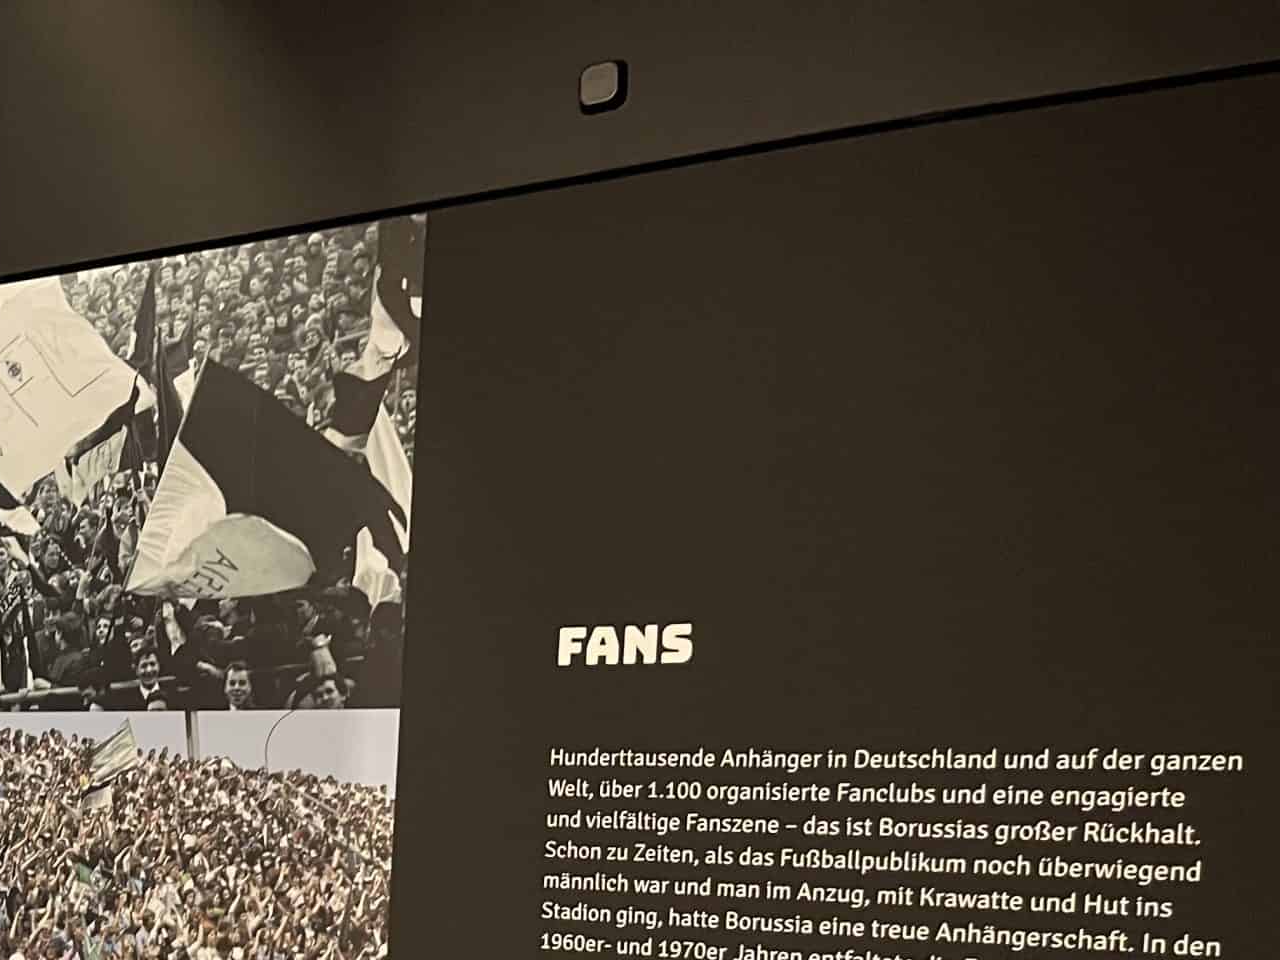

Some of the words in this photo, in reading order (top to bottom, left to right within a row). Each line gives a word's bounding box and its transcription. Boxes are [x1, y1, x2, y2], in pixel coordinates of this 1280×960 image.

[558, 623, 693, 667] FANS
[550, 746, 716, 768] Hunderttausende
[719, 747, 824, 774] Anhänger
[827, 749, 848, 769] in
[853, 747, 998, 770] Deutschland
[1003, 747, 1050, 770] und
[1055, 747, 1100, 770] auf
[1102, 747, 1146, 771] der
[1150, 754, 1244, 777] ganzen
[548, 777, 595, 801] Welt,
[599, 778, 644, 799] über
[647, 780, 702, 800] 1.100
[706, 781, 831, 806] organisierte
[836, 781, 937, 804] Fanclubs
[942, 783, 987, 805] und
[992, 784, 1045, 806] eine
[1050, 786, 1186, 813] engagierte
[543, 871, 629, 893] männlich
[633, 879, 671, 895] war
[674, 876, 712, 897] und
[716, 882, 761, 899] man
[765, 880, 792, 901] im
[795, 881, 871, 909] Anzug,
[876, 886, 915, 907] mit
[919, 887, 1024, 912] Krawatte
[1030, 891, 1077, 914] und
[1083, 893, 1131, 917] Hut
[1135, 895, 1174, 919] ins
[540, 932, 613, 953] 1960er-
[616, 936, 653, 957] und
[657, 939, 729, 960] 1970er
